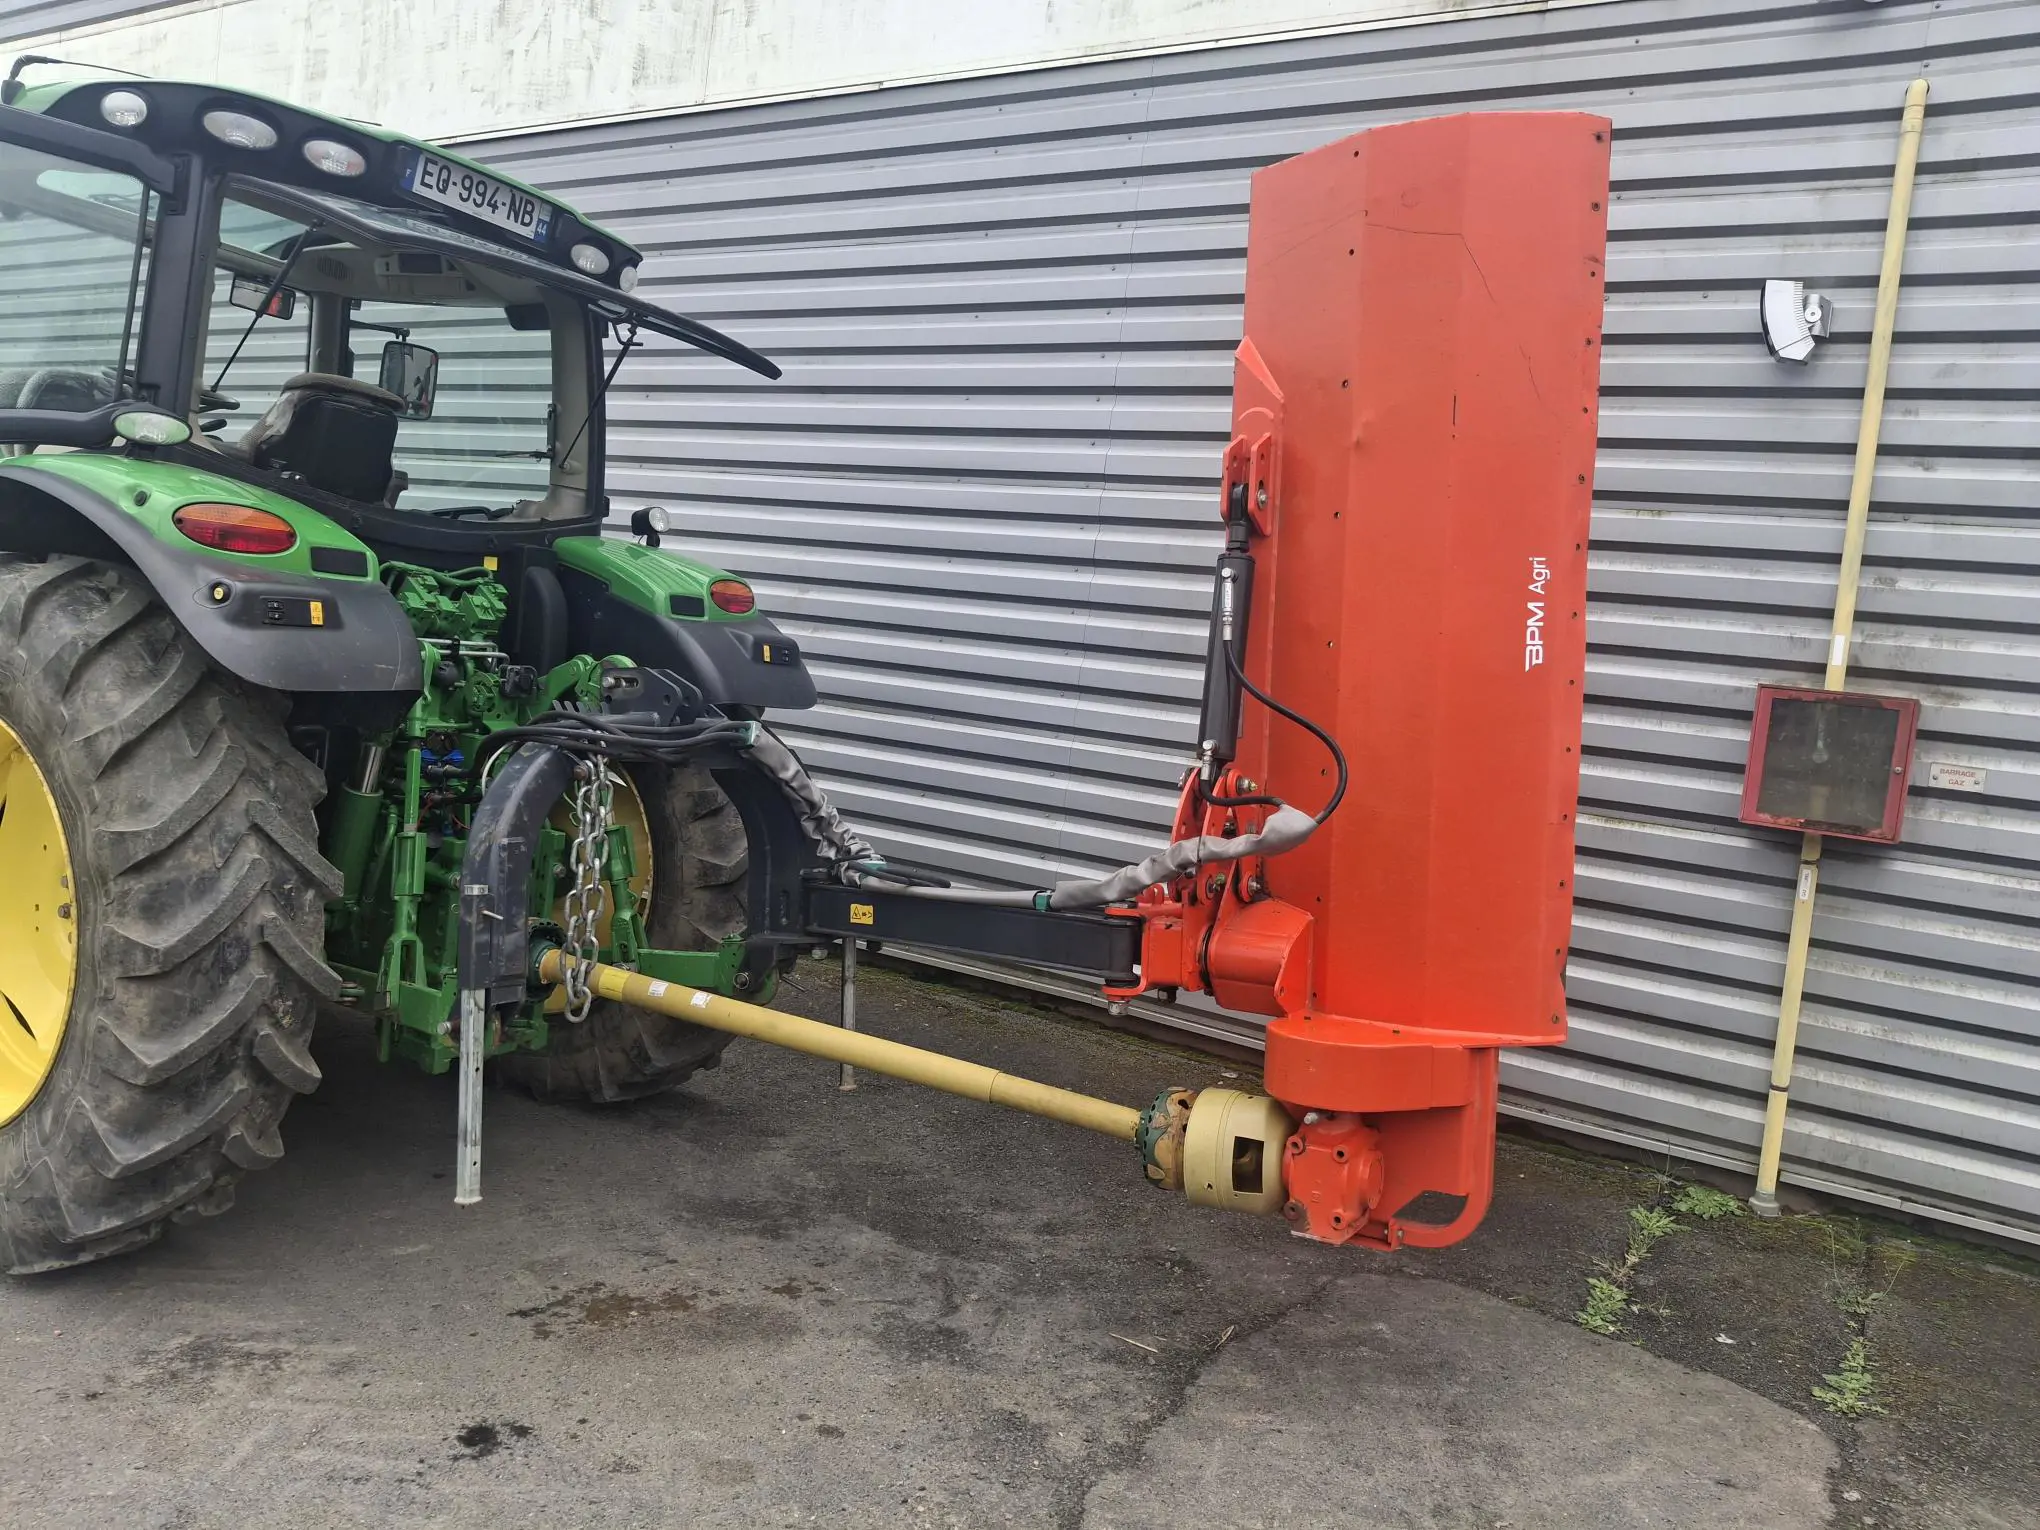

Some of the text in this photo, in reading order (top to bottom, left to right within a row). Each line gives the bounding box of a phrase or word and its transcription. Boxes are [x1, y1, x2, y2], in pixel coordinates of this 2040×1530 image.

[420, 156, 535, 227] EQ-994-NB
[537, 222, 547, 236] 44
[1525, 557, 1551, 672] BPM Agri
